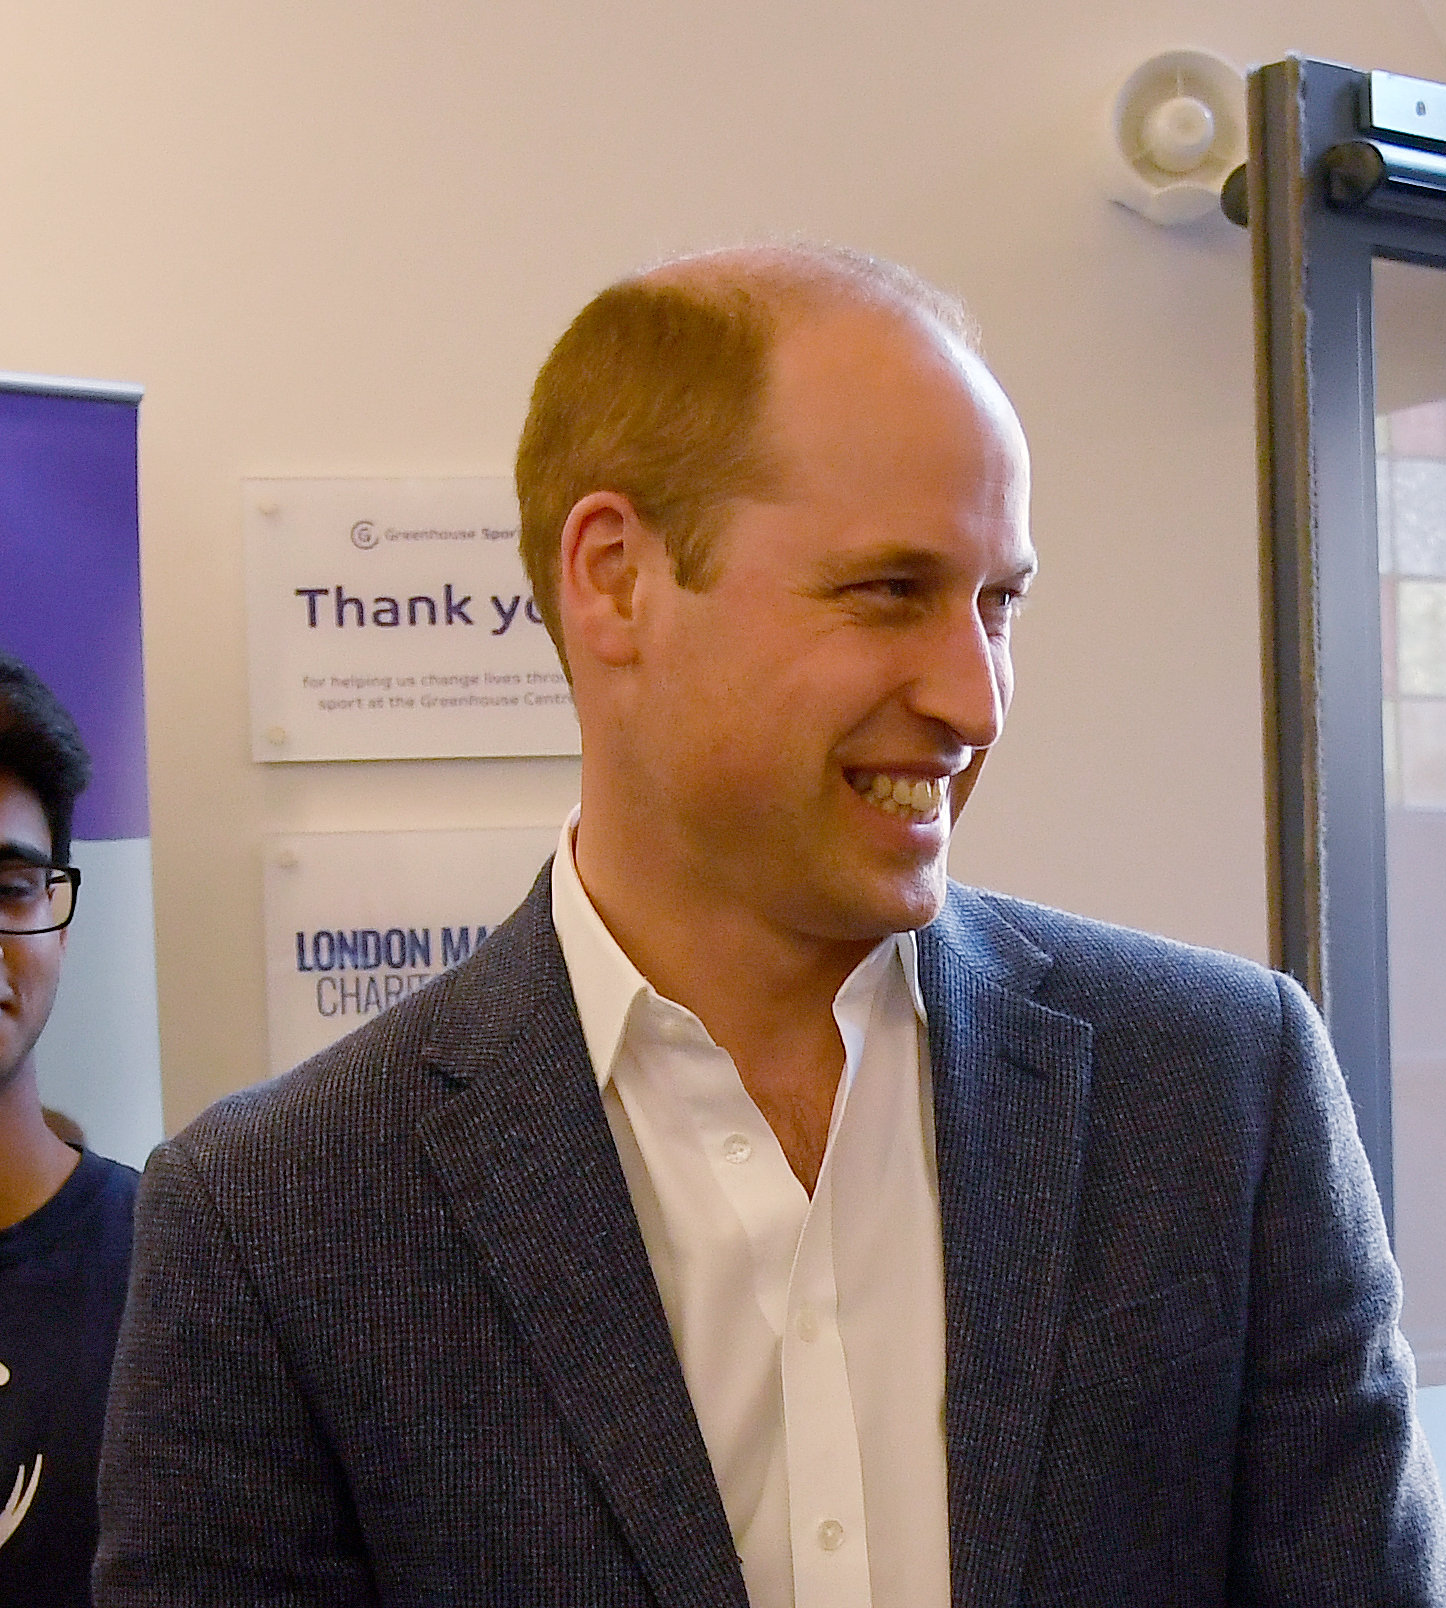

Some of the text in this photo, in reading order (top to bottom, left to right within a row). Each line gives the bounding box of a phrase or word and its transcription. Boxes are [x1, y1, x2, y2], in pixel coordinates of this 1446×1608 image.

[384, 527, 476, 542] Greenhouse
[294, 584, 474, 629] Thank
[302, 675, 326, 688] for
[330, 674, 392, 690] helping
[396, 675, 416, 687] us
[420, 672, 479, 688] change
[483, 672, 521, 685] lives
[317, 697, 362, 711] sport
[367, 697, 384, 709] at
[389, 696, 415, 709] the
[420, 694, 520, 710] Greenhouse
[295, 928, 432, 972] LONDON
